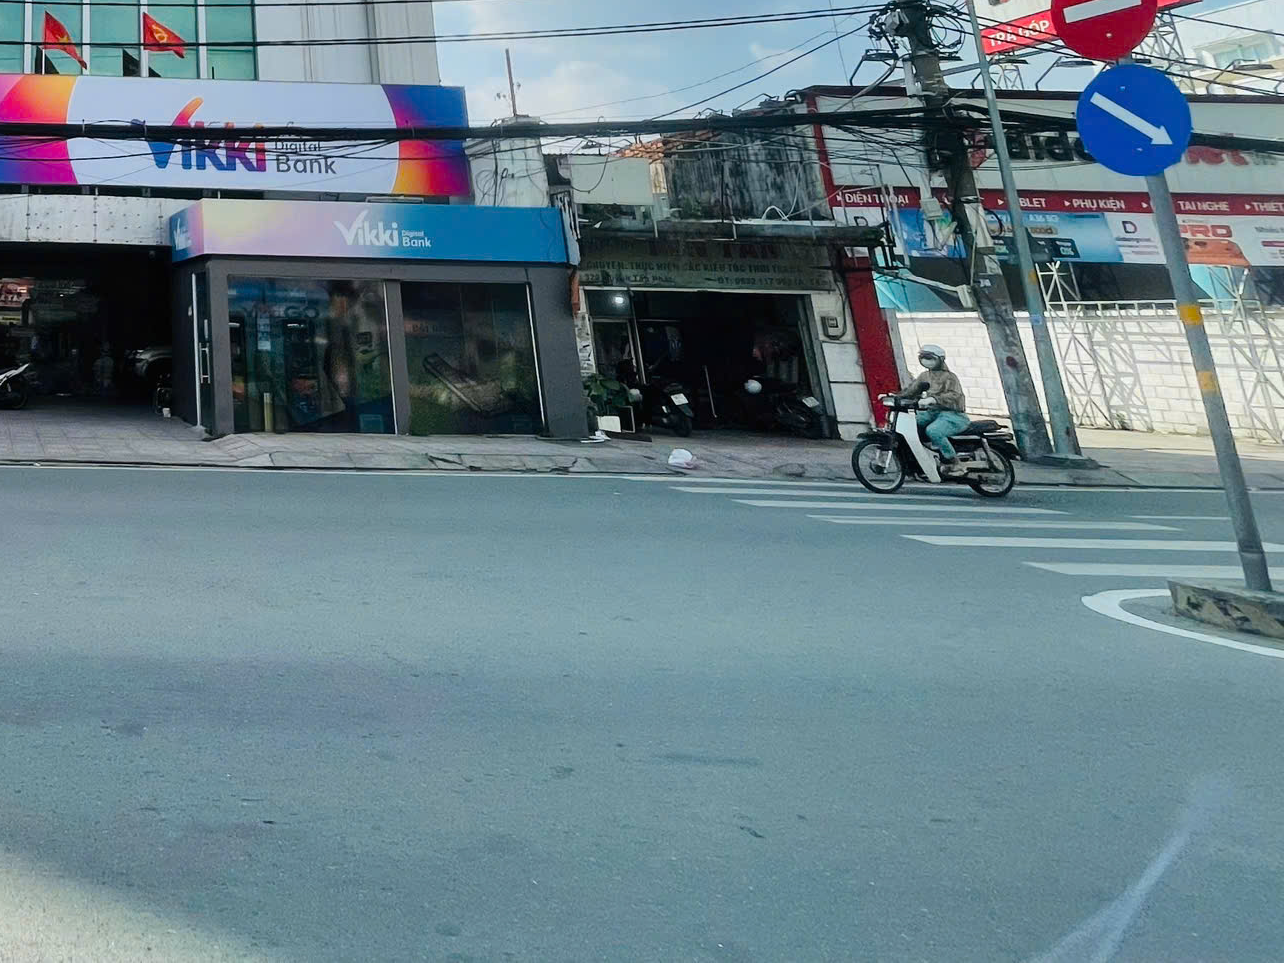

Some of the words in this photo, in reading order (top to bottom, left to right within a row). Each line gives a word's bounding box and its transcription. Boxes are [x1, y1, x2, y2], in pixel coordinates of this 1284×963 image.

[275, 154, 337, 175] Bank
[1072, 198, 1097, 211] PHỤ
[1099, 197, 1126, 212] KIỆN
[333, 208, 399, 247] Vikki
[402, 237, 432, 248] Bank
